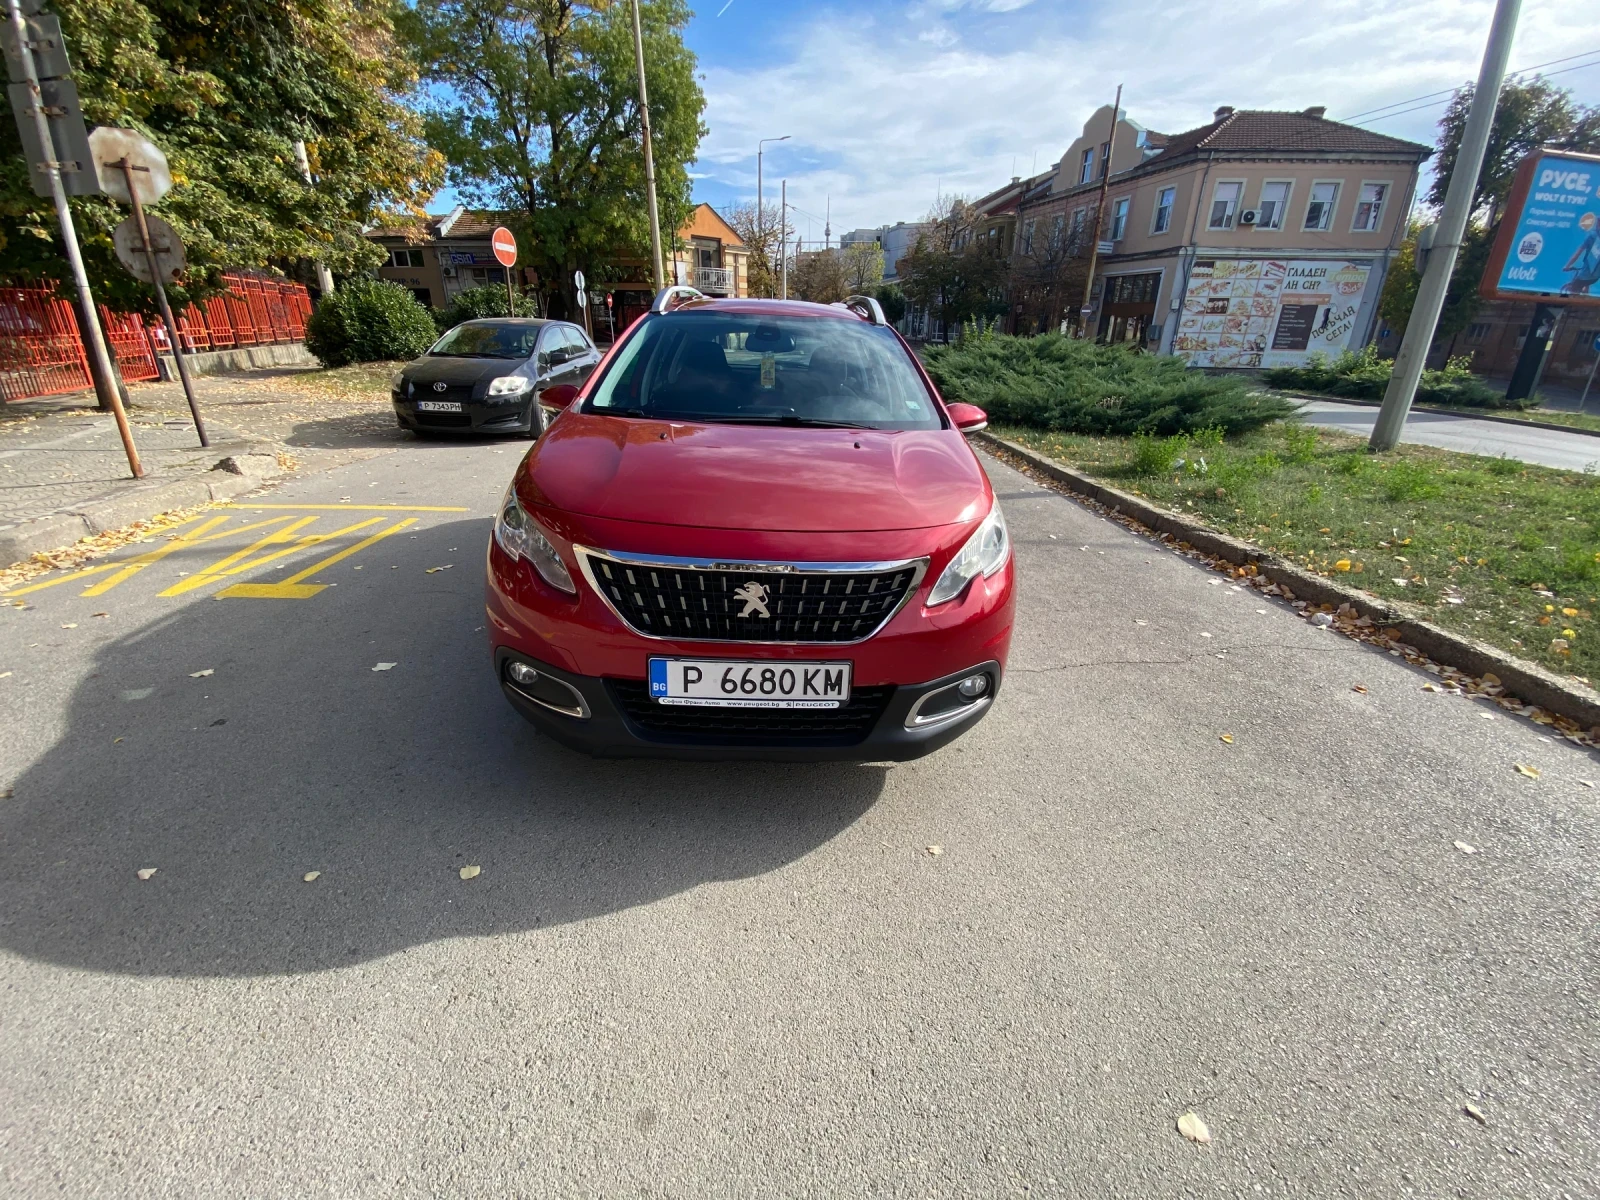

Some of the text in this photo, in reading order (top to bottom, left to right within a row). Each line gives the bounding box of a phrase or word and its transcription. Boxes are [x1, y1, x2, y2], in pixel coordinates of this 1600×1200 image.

[1539, 169, 1592, 194] РУСЕ,
[1507, 266, 1538, 281] Wolt
[653, 682, 667, 692] BG
[683, 666, 703, 693] P
